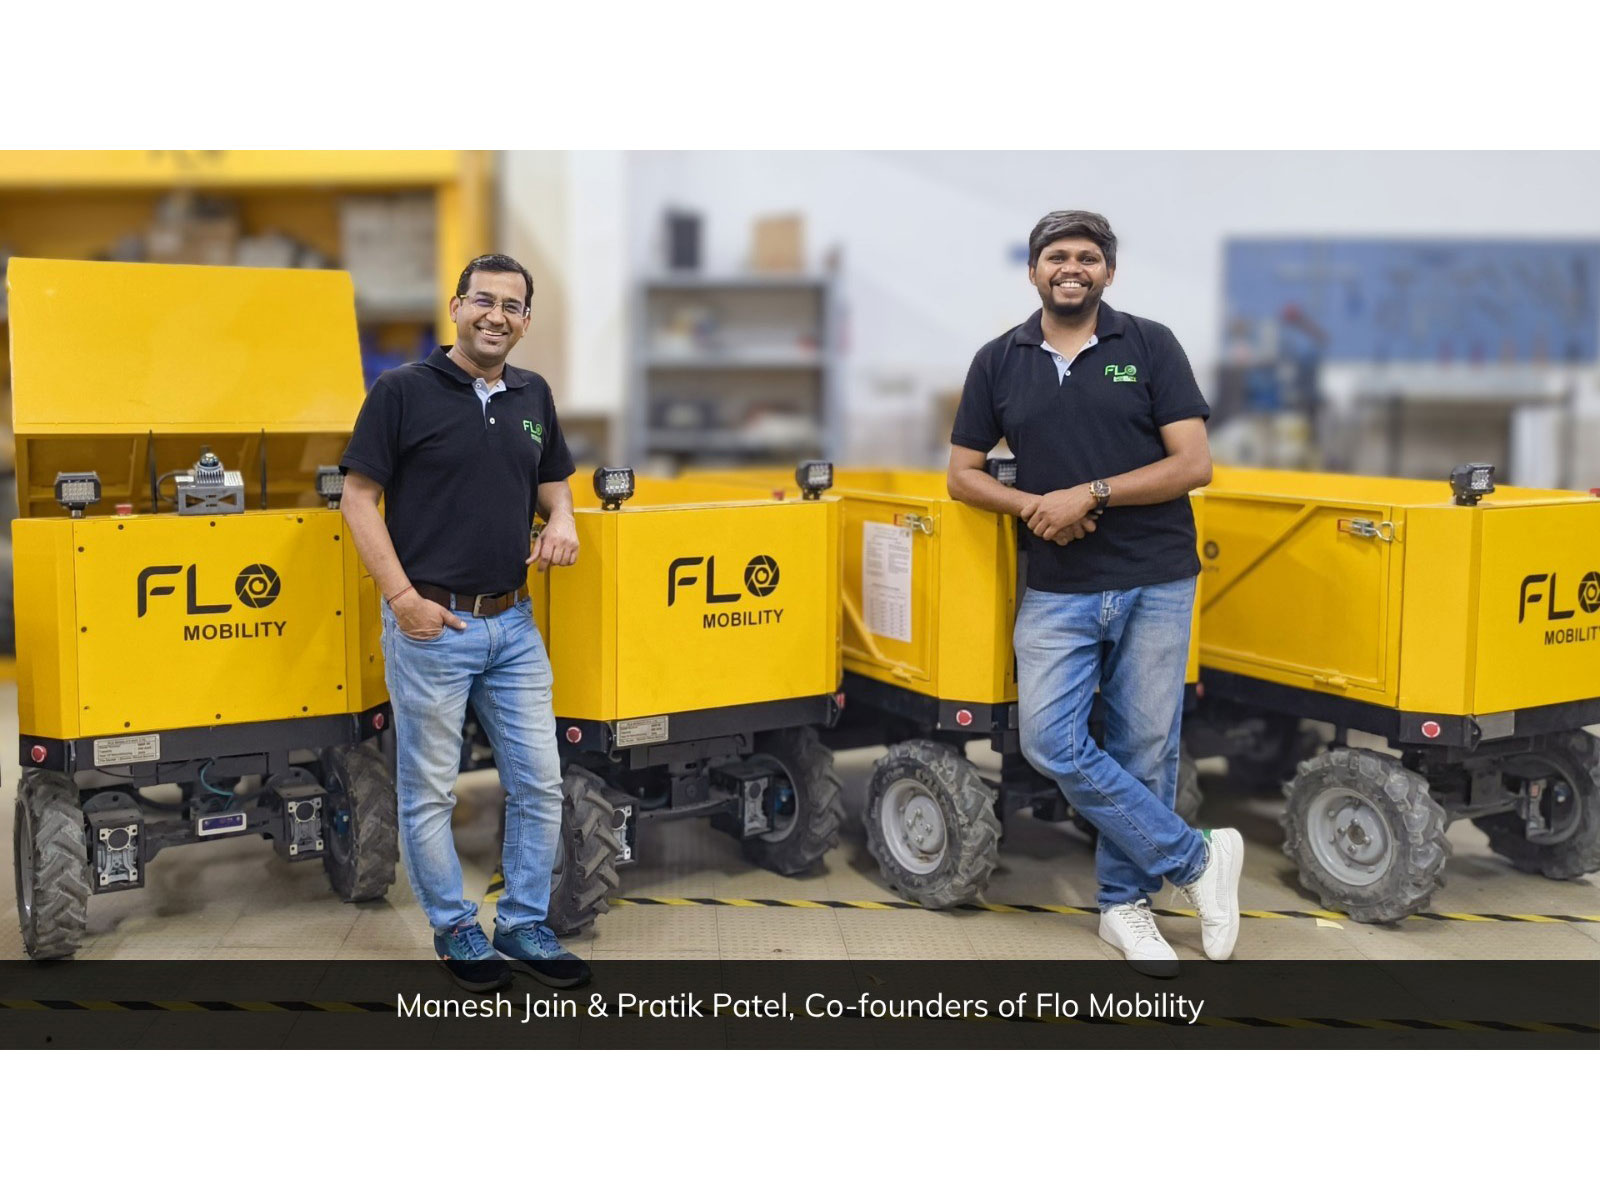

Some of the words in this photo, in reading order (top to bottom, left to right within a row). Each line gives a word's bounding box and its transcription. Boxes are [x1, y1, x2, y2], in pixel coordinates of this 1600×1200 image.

[1104, 364, 1137, 376] FLO
[522, 419, 543, 436] FLO
[137, 563, 281, 618] FLO
[667, 554, 780, 607] FLO
[1518, 571, 1600, 624] FLO
[703, 609, 784, 628] MOBILITY
[184, 621, 287, 641] MOBILITY
[1544, 625, 1600, 645] MOBILIT
